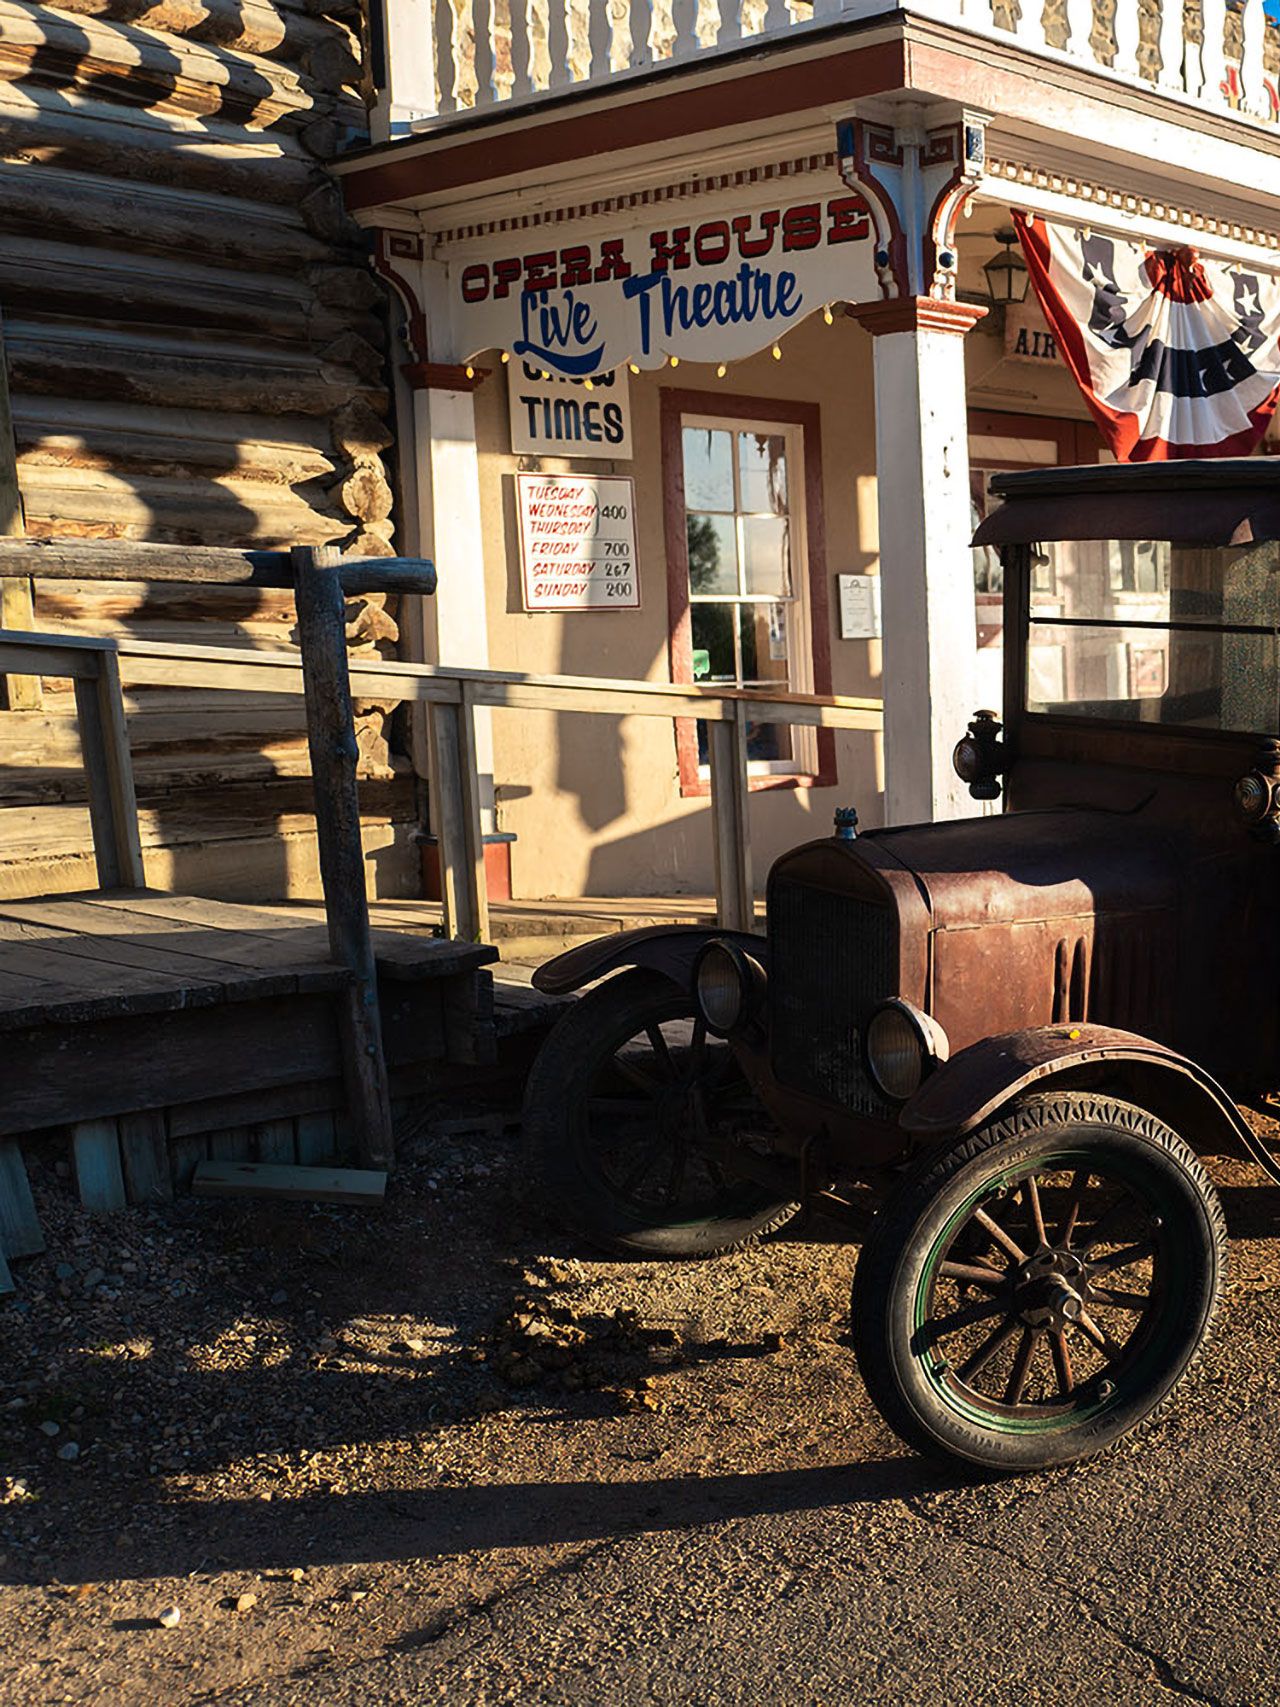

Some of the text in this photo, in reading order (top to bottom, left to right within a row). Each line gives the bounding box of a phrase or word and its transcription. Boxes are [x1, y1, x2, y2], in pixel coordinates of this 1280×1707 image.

[462, 196, 870, 303] OPERA HOUSE
[513, 263, 802, 375] Live Theatre
[519, 396, 624, 444] TIMES
[527, 486, 584, 501] TUESDAY
[528, 504, 597, 518] WEDNESDAY
[530, 521, 591, 536] THURSDAY
[531, 542, 579, 556] FRIDAY
[532, 562, 596, 577] SATURDAY
[534, 583, 588, 598] SUNDAY
